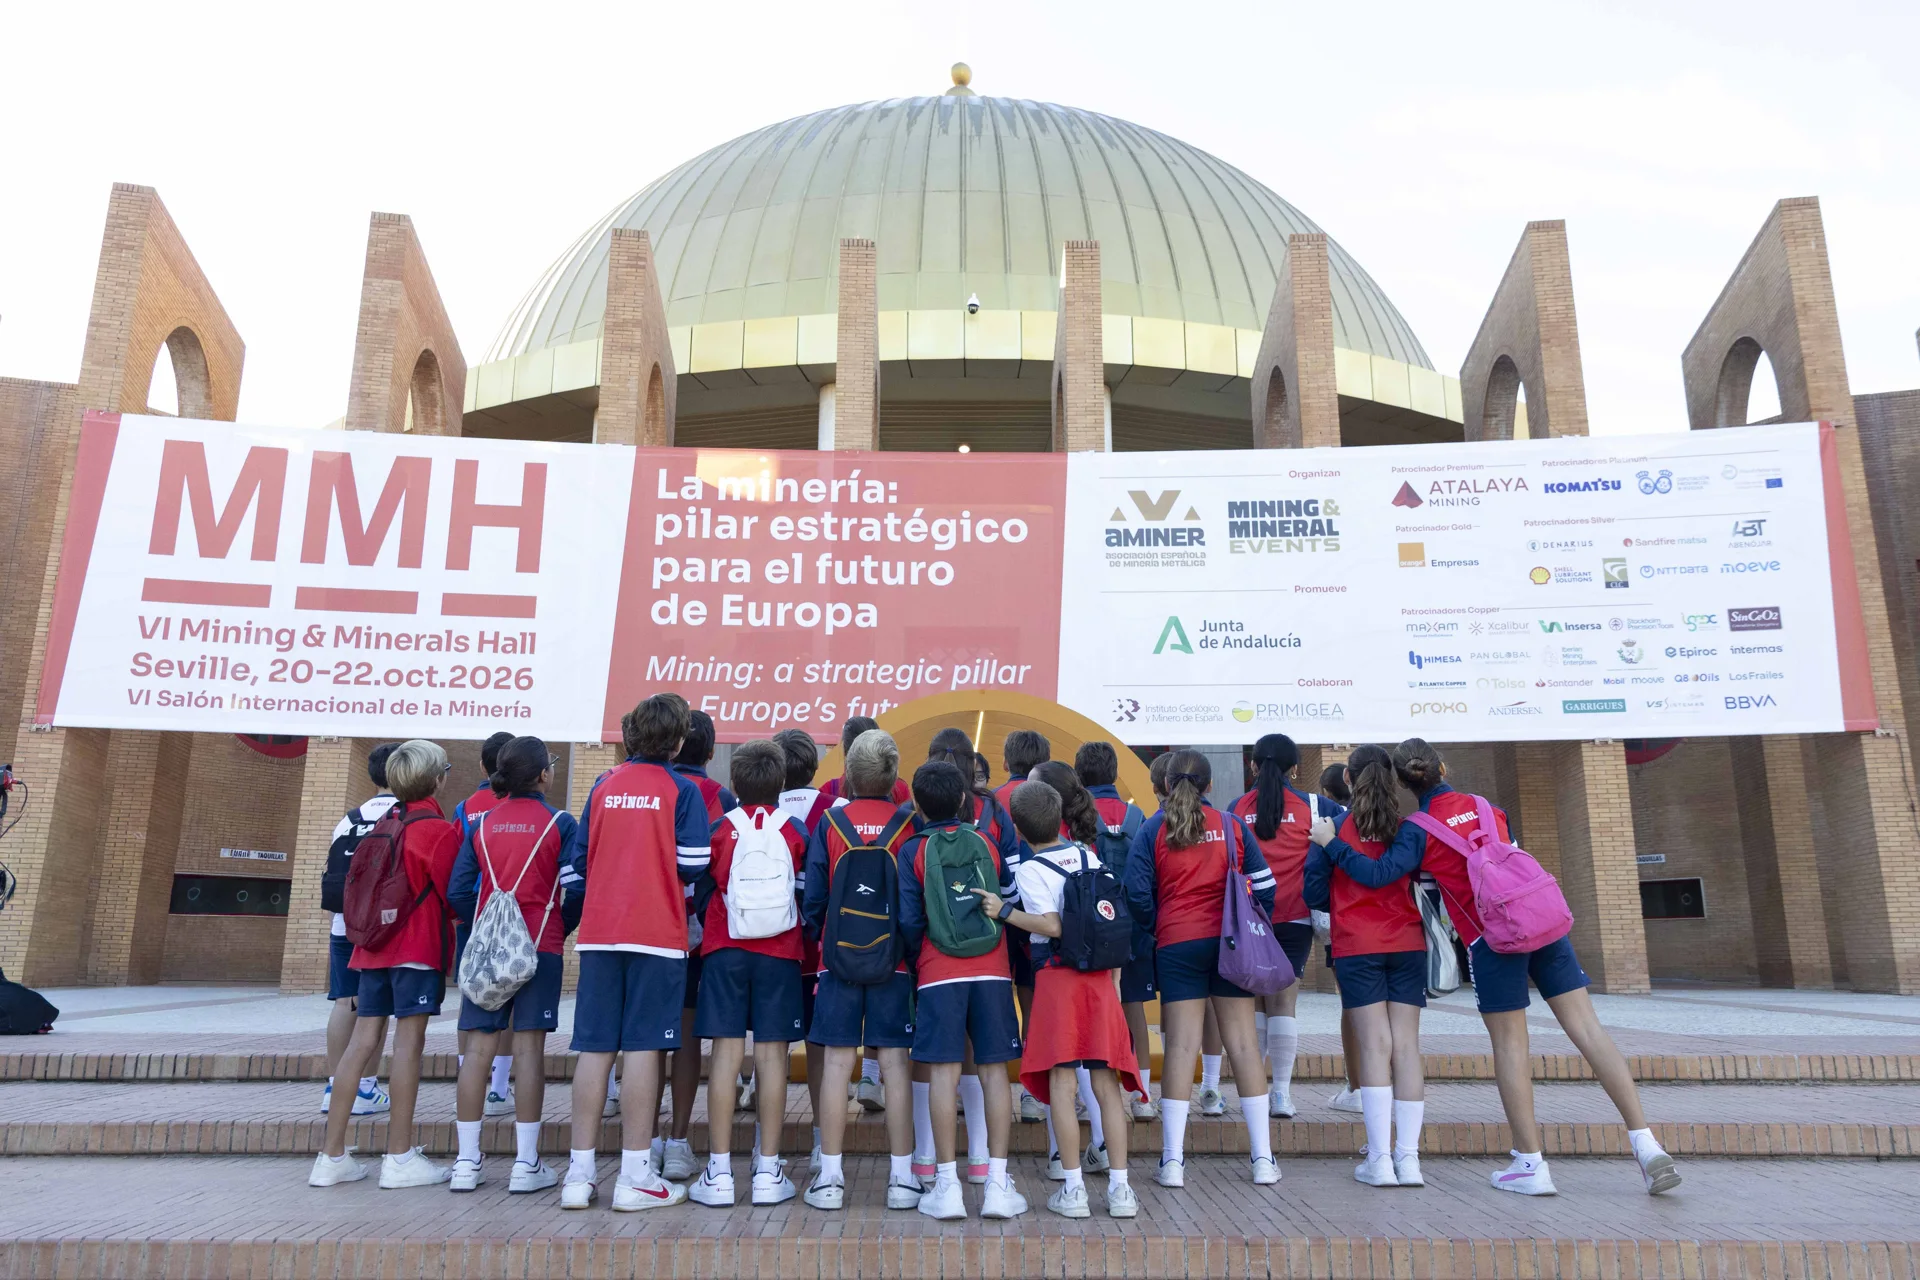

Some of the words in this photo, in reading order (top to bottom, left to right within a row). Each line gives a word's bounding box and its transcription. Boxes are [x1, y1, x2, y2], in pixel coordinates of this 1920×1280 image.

[1288, 469, 1341, 479] Organizan
[1391, 464, 1445, 473] Patrocinador
[657, 468, 703, 501] La
[716, 469, 898, 504] minería:
[1429, 477, 1529, 494] ATALAYA
[1543, 478, 1622, 494] KOMATSU
[148, 439, 548, 573] MMH
[1429, 497, 1481, 507] MINING
[1228, 499, 1319, 519] MINING
[1322, 498, 1341, 516] &
[1451, 523, 1472, 531] Gold
[1524, 518, 1589, 527] Patrocinadores
[1590, 516, 1615, 524] Silver
[654, 507, 758, 545] pilar
[770, 508, 1029, 550] estratégico
[1228, 519, 1339, 538] MINERAL
[1229, 538, 1341, 554] EVENTS
[1542, 540, 1593, 549] DENARIUS
[1635, 537, 1676, 546] Sandfire
[1677, 537, 1707, 545] matsa
[1431, 559, 1480, 568] Empresas
[1720, 560, 1781, 574] moeve
[652, 555, 751, 589] para
[764, 553, 803, 584] el
[815, 553, 955, 587] futuro
[1656, 567, 1680, 575] NTT
[1294, 584, 1347, 594] Promueve
[650, 594, 707, 626] de
[721, 594, 878, 635] Europa
[1401, 607, 1466, 616] Patrocinadores
[1467, 606, 1500, 614] Copper
[1199, 619, 1244, 633] Junta
[1487, 621, 1529, 630] Xcalibur
[138, 616, 171, 641] VI
[179, 618, 295, 651] Mining
[302, 623, 326, 648] &
[333, 626, 470, 654] Minerals
[477, 631, 537, 655] Hall
[1199, 635, 1219, 649] de
[1222, 633, 1302, 649] Andalucía
[1679, 646, 1718, 659] Epiroc
[1730, 644, 1783, 655] intermas
[1424, 655, 1462, 663] HIMESA
[1470, 652, 1490, 660] PAN
[1493, 651, 1531, 659] GLOBAL
[130, 652, 258, 687] Seville,
[646, 656, 763, 689] Mining:
[774, 663, 793, 684] a
[803, 659, 943, 690] strategic
[950, 659, 1032, 690] pillar
[1297, 678, 1353, 687] Colaboran
[1493, 678, 1526, 689] Tolsa
[1547, 679, 1594, 688] Santander
[1631, 676, 1665, 684] moove
[1674, 675, 1689, 683] Q8
[1700, 673, 1720, 682] Oils
[127, 689, 151, 706] VI
[156, 690, 224, 710] Salón
[231, 693, 387, 715] Internacional
[390, 697, 418, 716] de
[422, 698, 444, 717] la
[447, 698, 532, 718] Minería
[1565, 702, 1623, 711] GARRIGUES
[1724, 694, 1777, 710] BBVA
[1145, 704, 1178, 713] Instituto
[1179, 704, 1220, 714] Geológico
[1256, 703, 1344, 717] PRIMIGEA
[1410, 702, 1468, 717] proxa
[1152, 714, 1181, 722] Minero
[1183, 714, 1193, 722] de
[1195, 713, 1224, 724] España
[604, 793, 660, 810] SPÍNOLA
[1245, 813, 1296, 824] SPLA
[1446, 809, 1478, 827] SPÍNOL
[492, 822, 535, 833] SPÍNOLA
[854, 823, 886, 835] PÍNO
